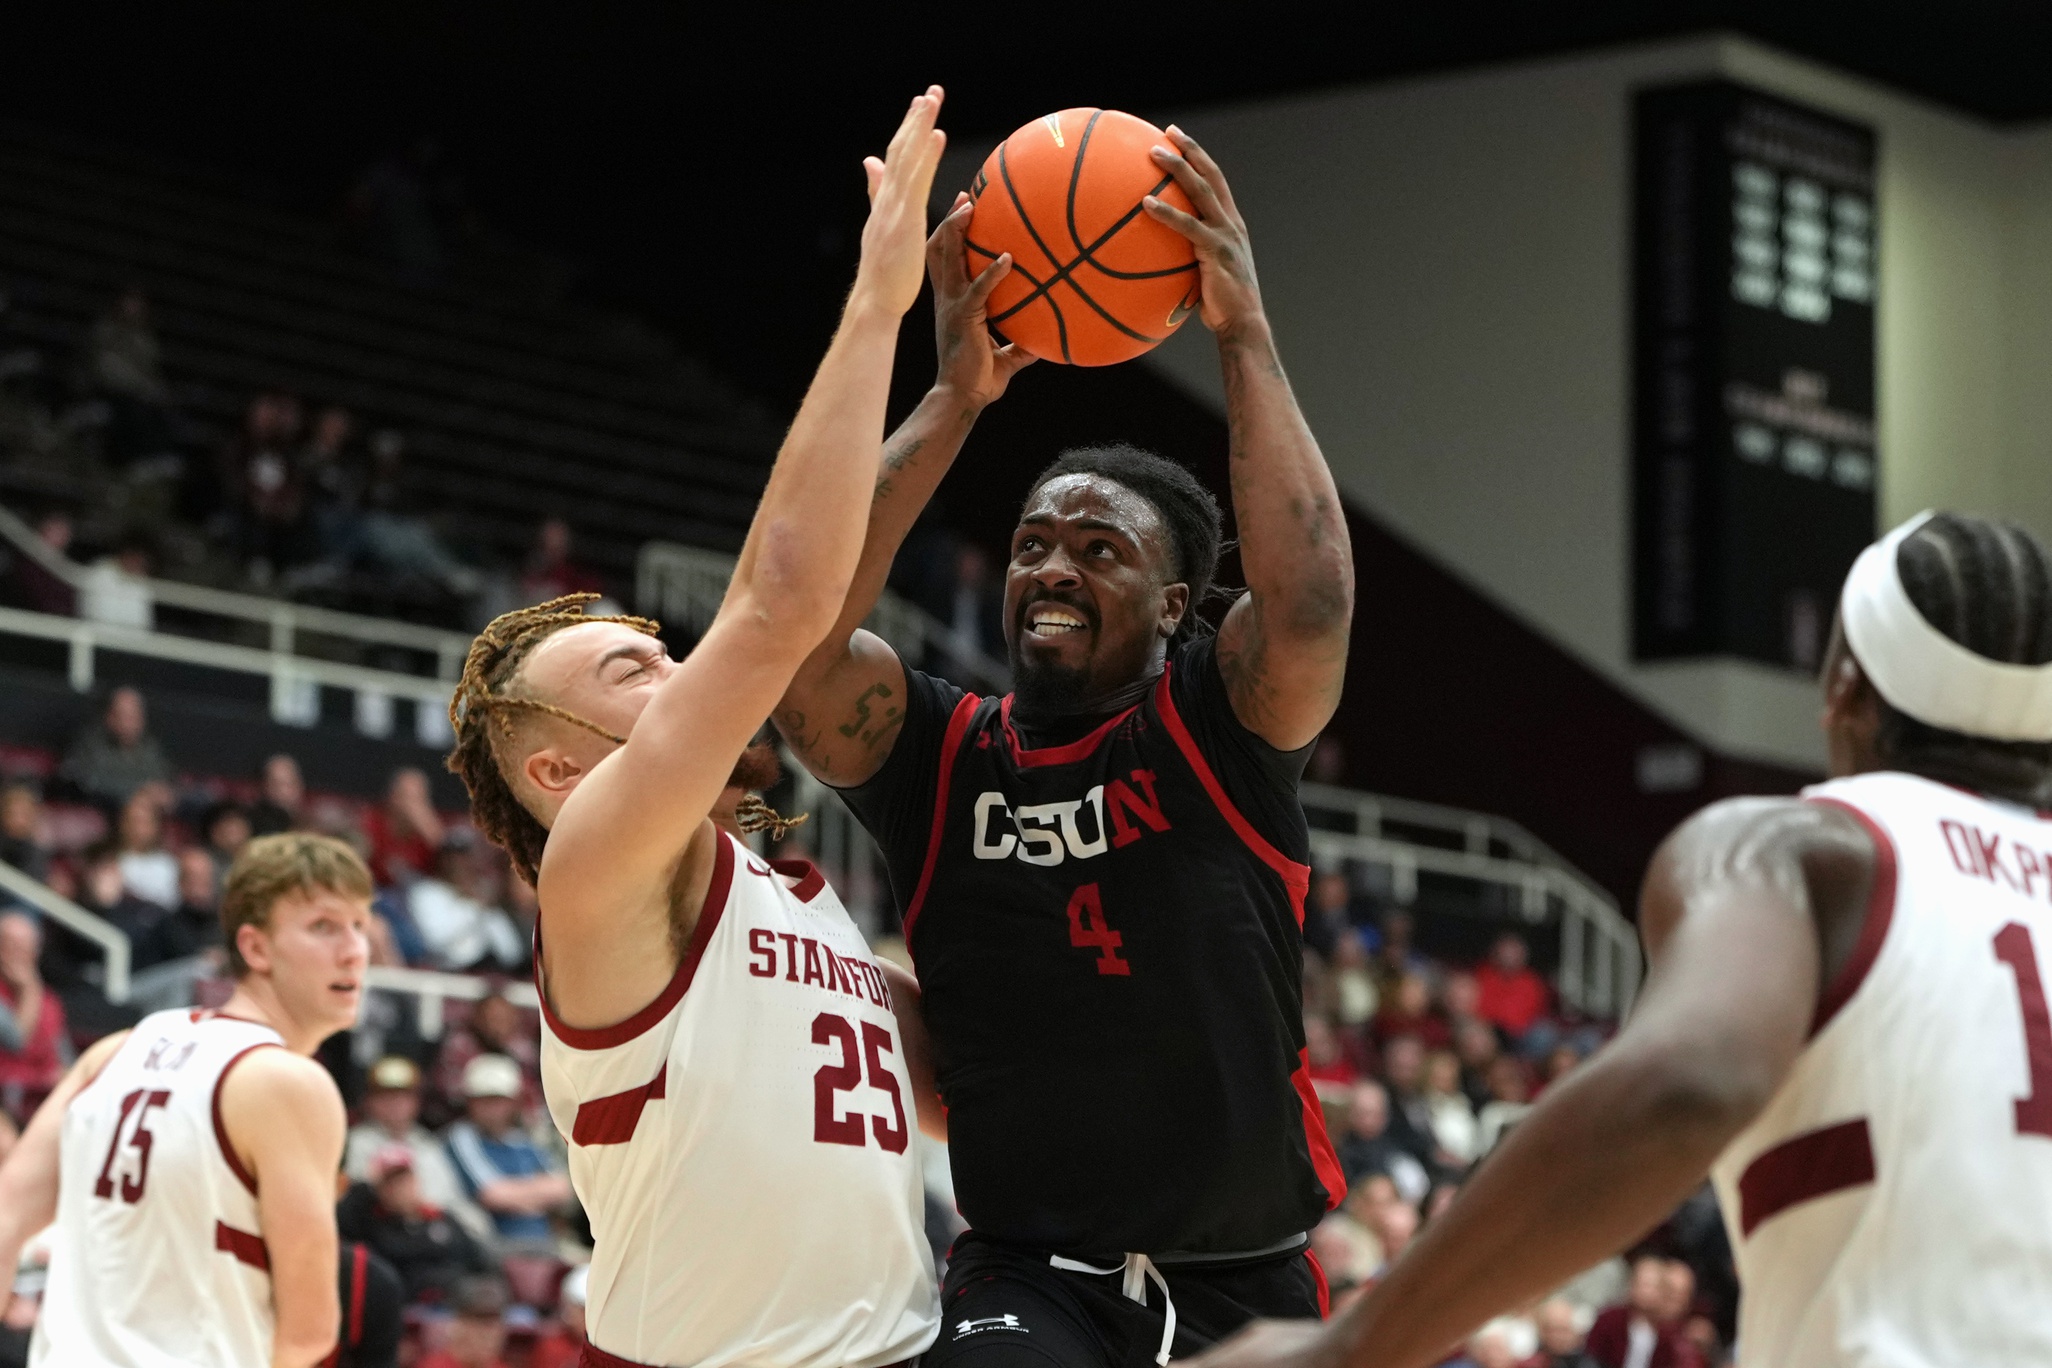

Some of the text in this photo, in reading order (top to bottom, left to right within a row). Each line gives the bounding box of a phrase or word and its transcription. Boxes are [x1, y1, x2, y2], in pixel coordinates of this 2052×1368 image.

[973, 768, 1172, 866] CSUN
[749, 928, 896, 1013] STANFOR
[1067, 883, 1131, 975] 4
[1993, 920, 2052, 1139] 1
[811, 1012, 909, 1156] 25
[94, 1088, 172, 1204] 15
[952, 1328, 984, 1341] UNDER
